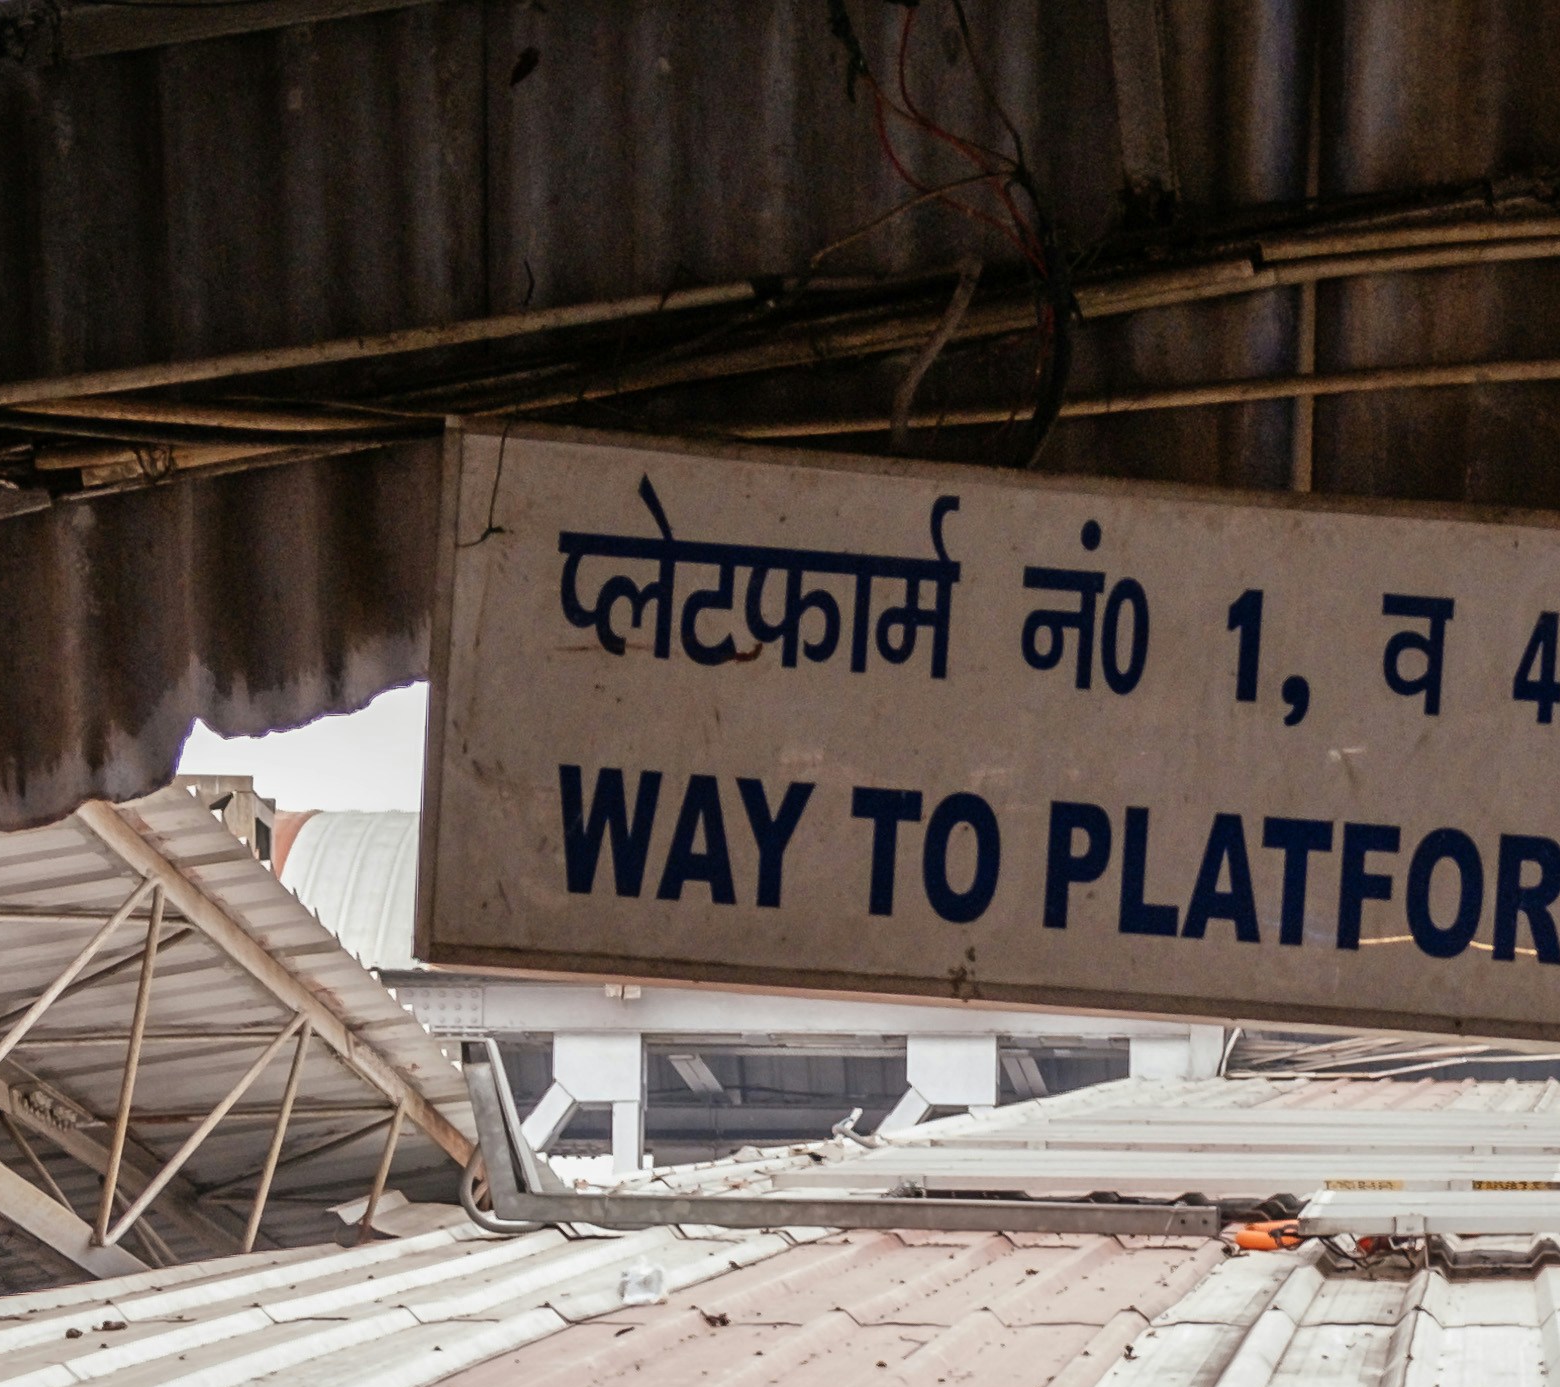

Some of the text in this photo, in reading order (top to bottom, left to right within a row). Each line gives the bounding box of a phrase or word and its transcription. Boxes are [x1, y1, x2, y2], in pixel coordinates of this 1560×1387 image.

[1226, 588, 1311, 728] 1,
[1381, 592, 1456, 716] व
[557, 763, 816, 909] WAY
[850, 785, 1002, 925] TO
